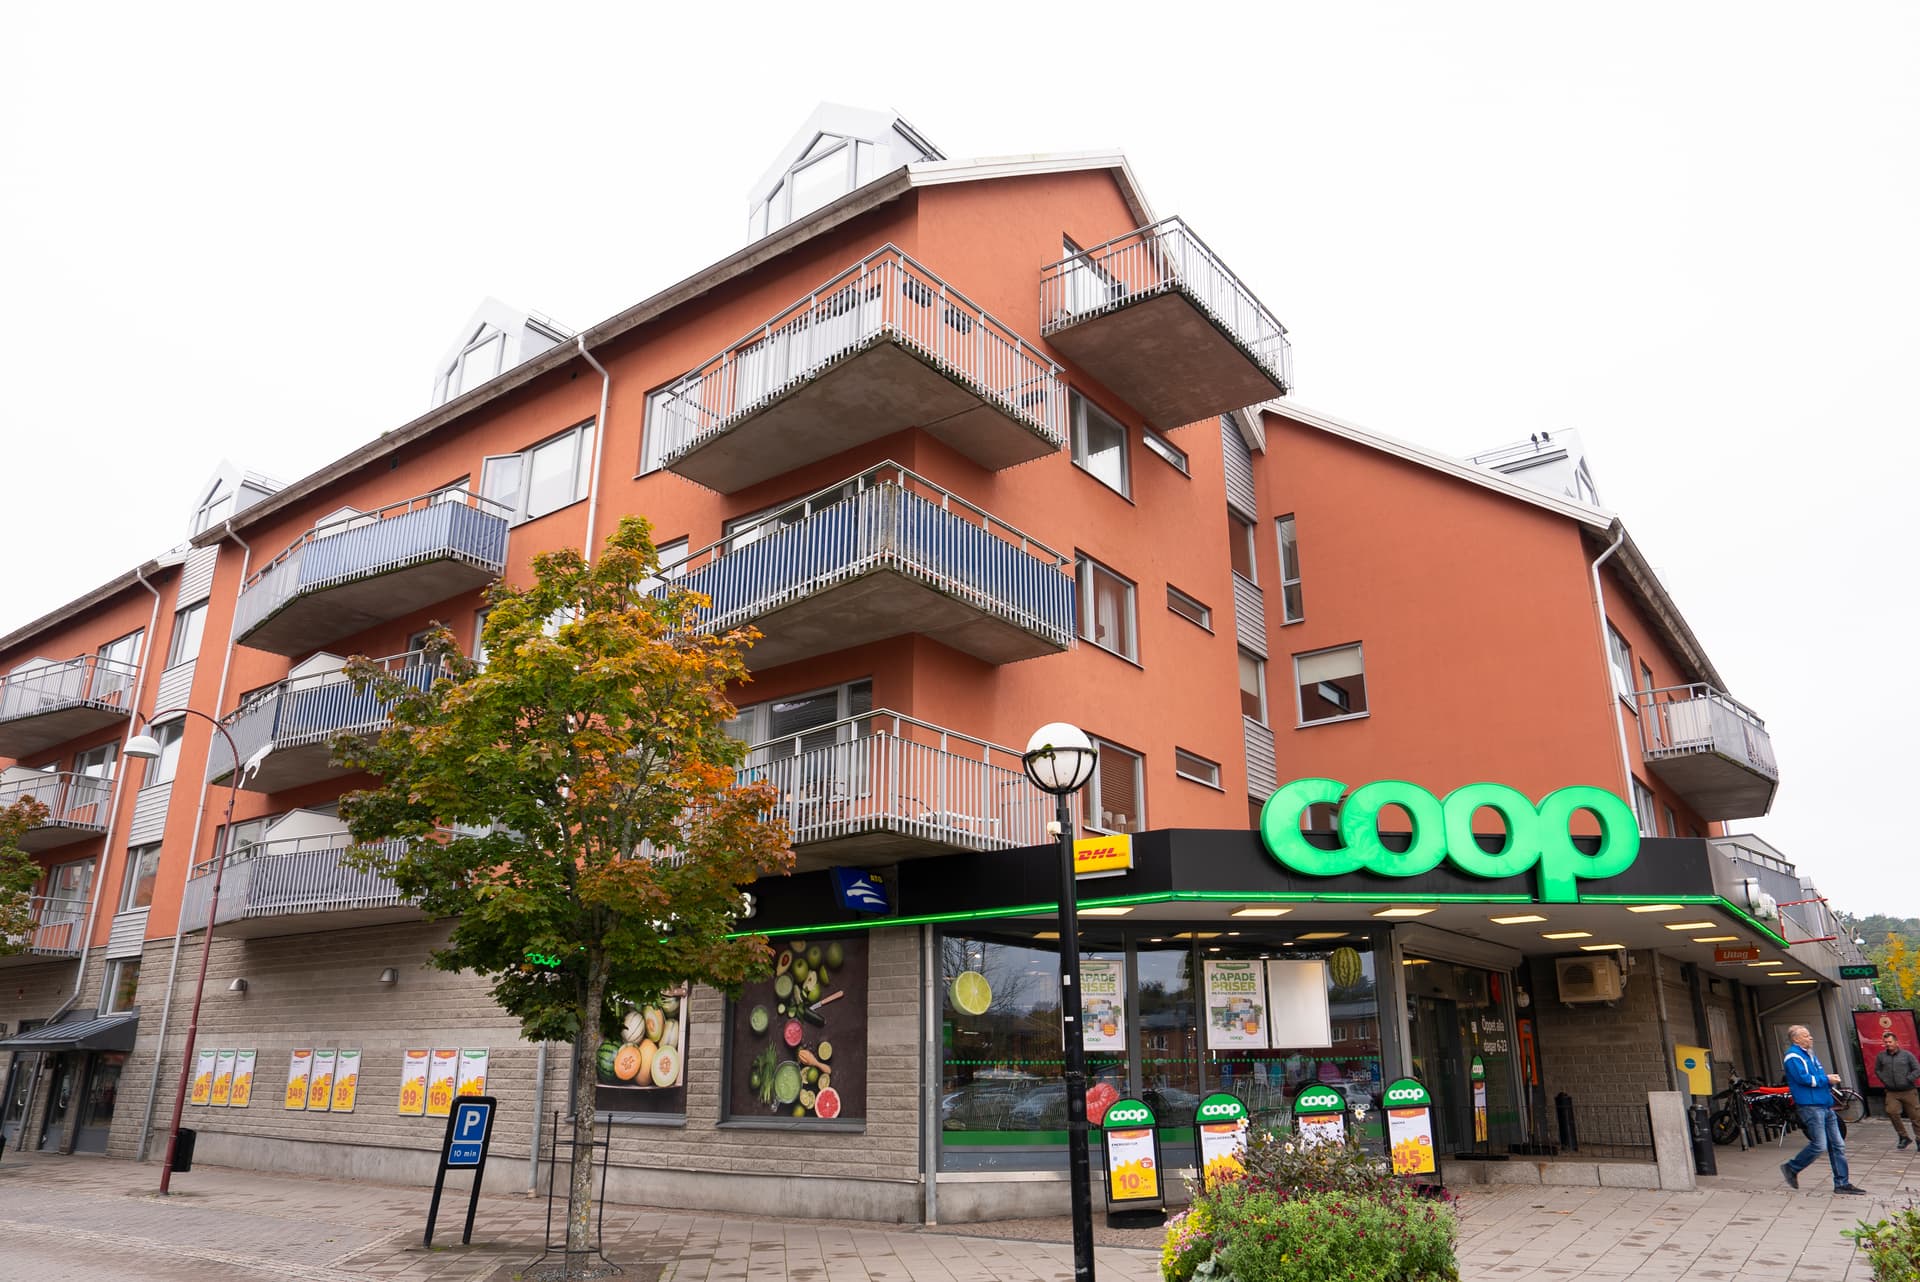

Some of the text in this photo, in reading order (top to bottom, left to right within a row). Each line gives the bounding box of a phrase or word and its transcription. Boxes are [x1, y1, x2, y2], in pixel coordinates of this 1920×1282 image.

[1259, 777, 1641, 904] coop
[1078, 847, 1118, 861] DHL
[1080, 974, 1116, 982] APADE
[1211, 973, 1256, 982] KAPADE
[1842, 967, 1874, 977] coop
[1081, 982, 1116, 992] RISER
[1212, 982, 1256, 991] PRISER
[1300, 1094, 1338, 1108] coop
[1388, 1087, 1424, 1101] coop
[1109, 1108, 1148, 1122] coop
[1202, 1103, 1241, 1117] coop
[462, 1110, 480, 1137] P
[453, 1150, 477, 1158] 10 min
